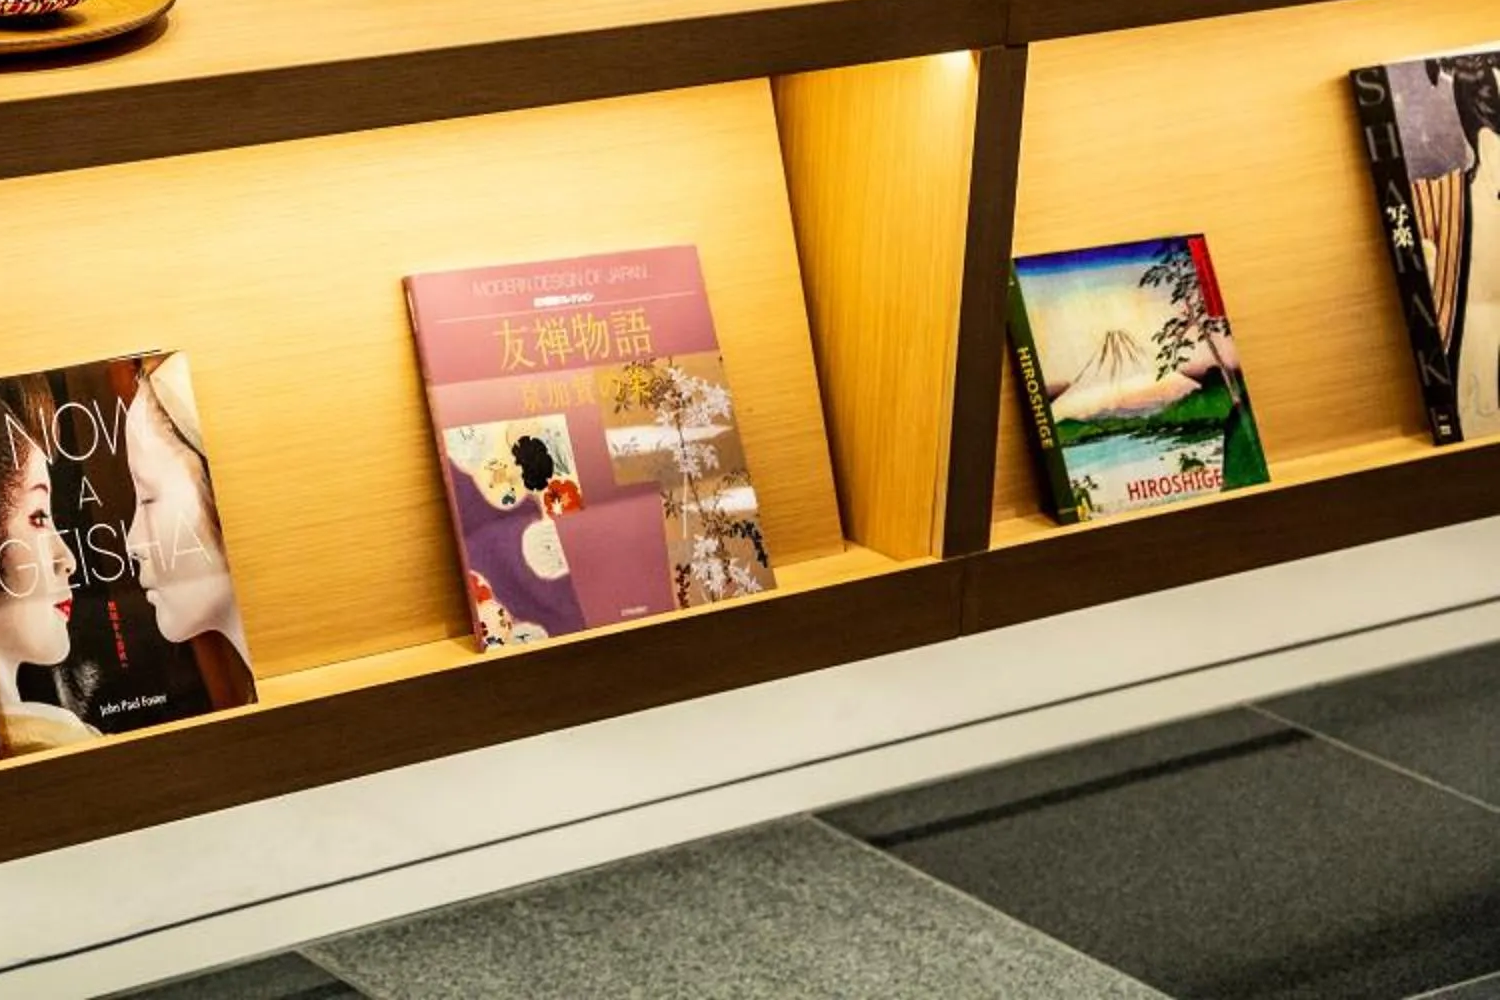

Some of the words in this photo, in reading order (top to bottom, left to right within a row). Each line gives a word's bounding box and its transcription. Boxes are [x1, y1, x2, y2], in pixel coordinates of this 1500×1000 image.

[1017, 347, 1054, 448] HIROSHIGE
[4, 396, 148, 469] NOW
[79, 475, 104, 510] A
[1127, 467, 1224, 501] HIROSHIGE
